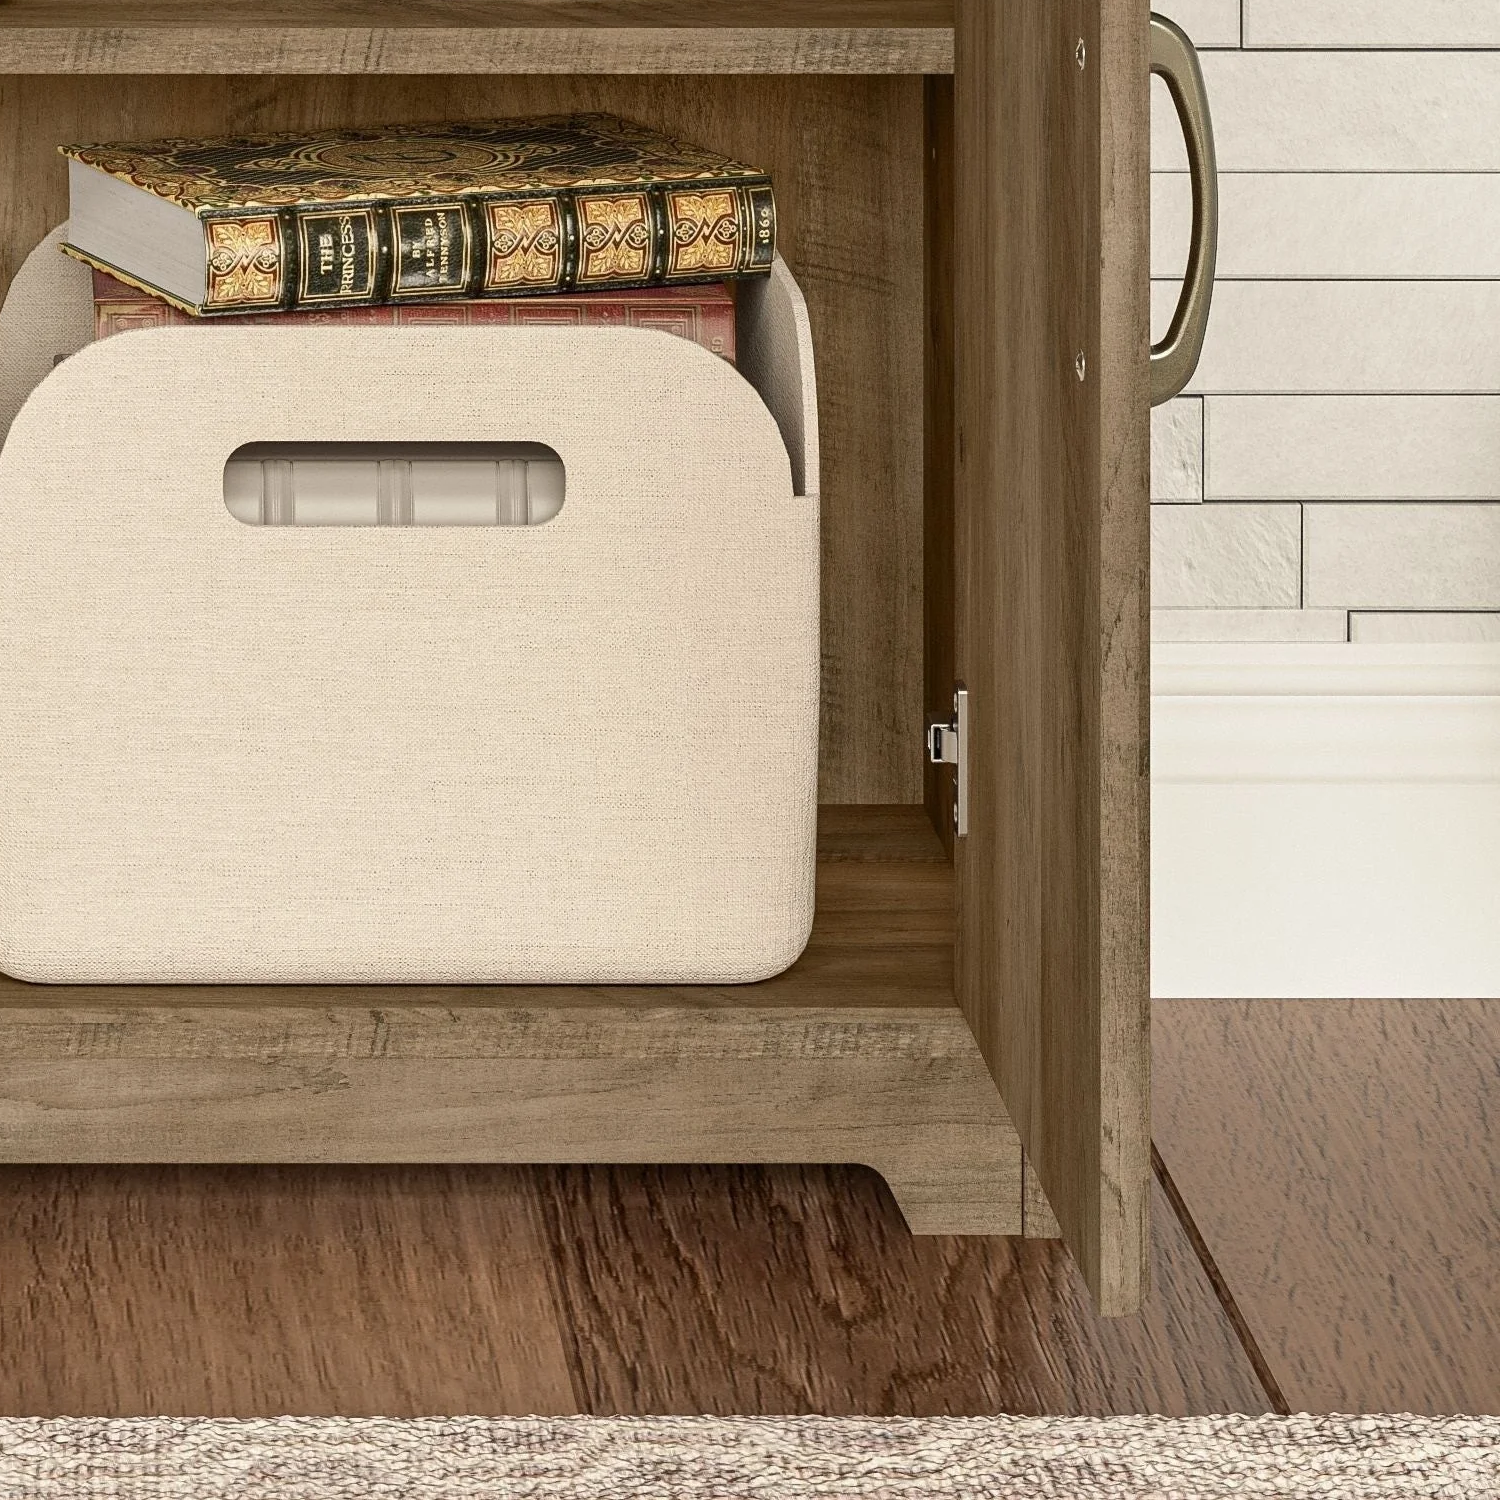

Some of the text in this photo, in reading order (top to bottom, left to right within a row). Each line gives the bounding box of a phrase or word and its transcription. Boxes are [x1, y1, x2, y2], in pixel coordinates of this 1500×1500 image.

[318, 232, 335, 276] THE
[338, 215, 357, 295] PRINCESS
[411, 240, 423, 259] BY
[424, 217, 436, 279] ALFRED
[436, 211, 450, 284] TENNYSON
